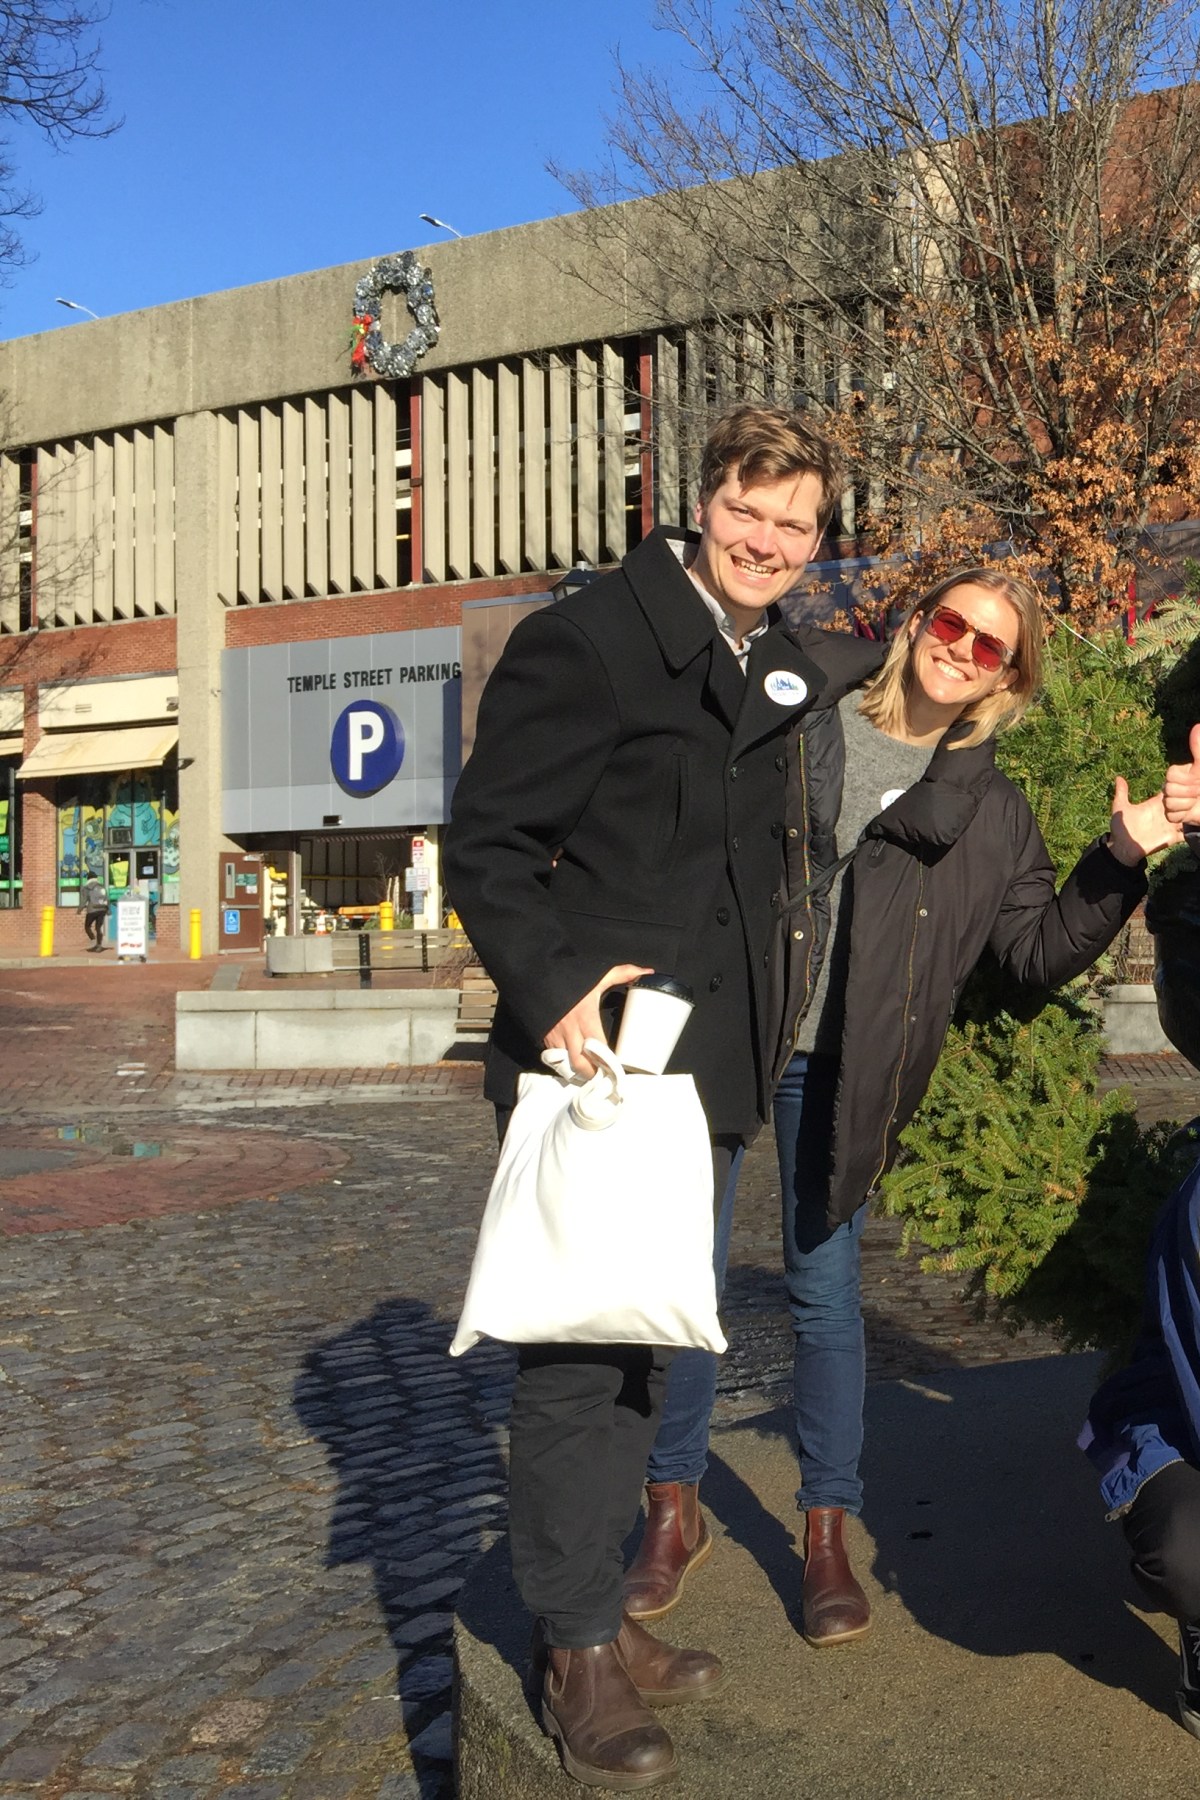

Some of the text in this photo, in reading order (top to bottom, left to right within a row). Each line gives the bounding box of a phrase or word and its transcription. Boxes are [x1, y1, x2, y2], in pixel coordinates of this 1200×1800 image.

[287, 662, 462, 693] TEMPLE STREET PARKING
[348, 710, 385, 781] P
